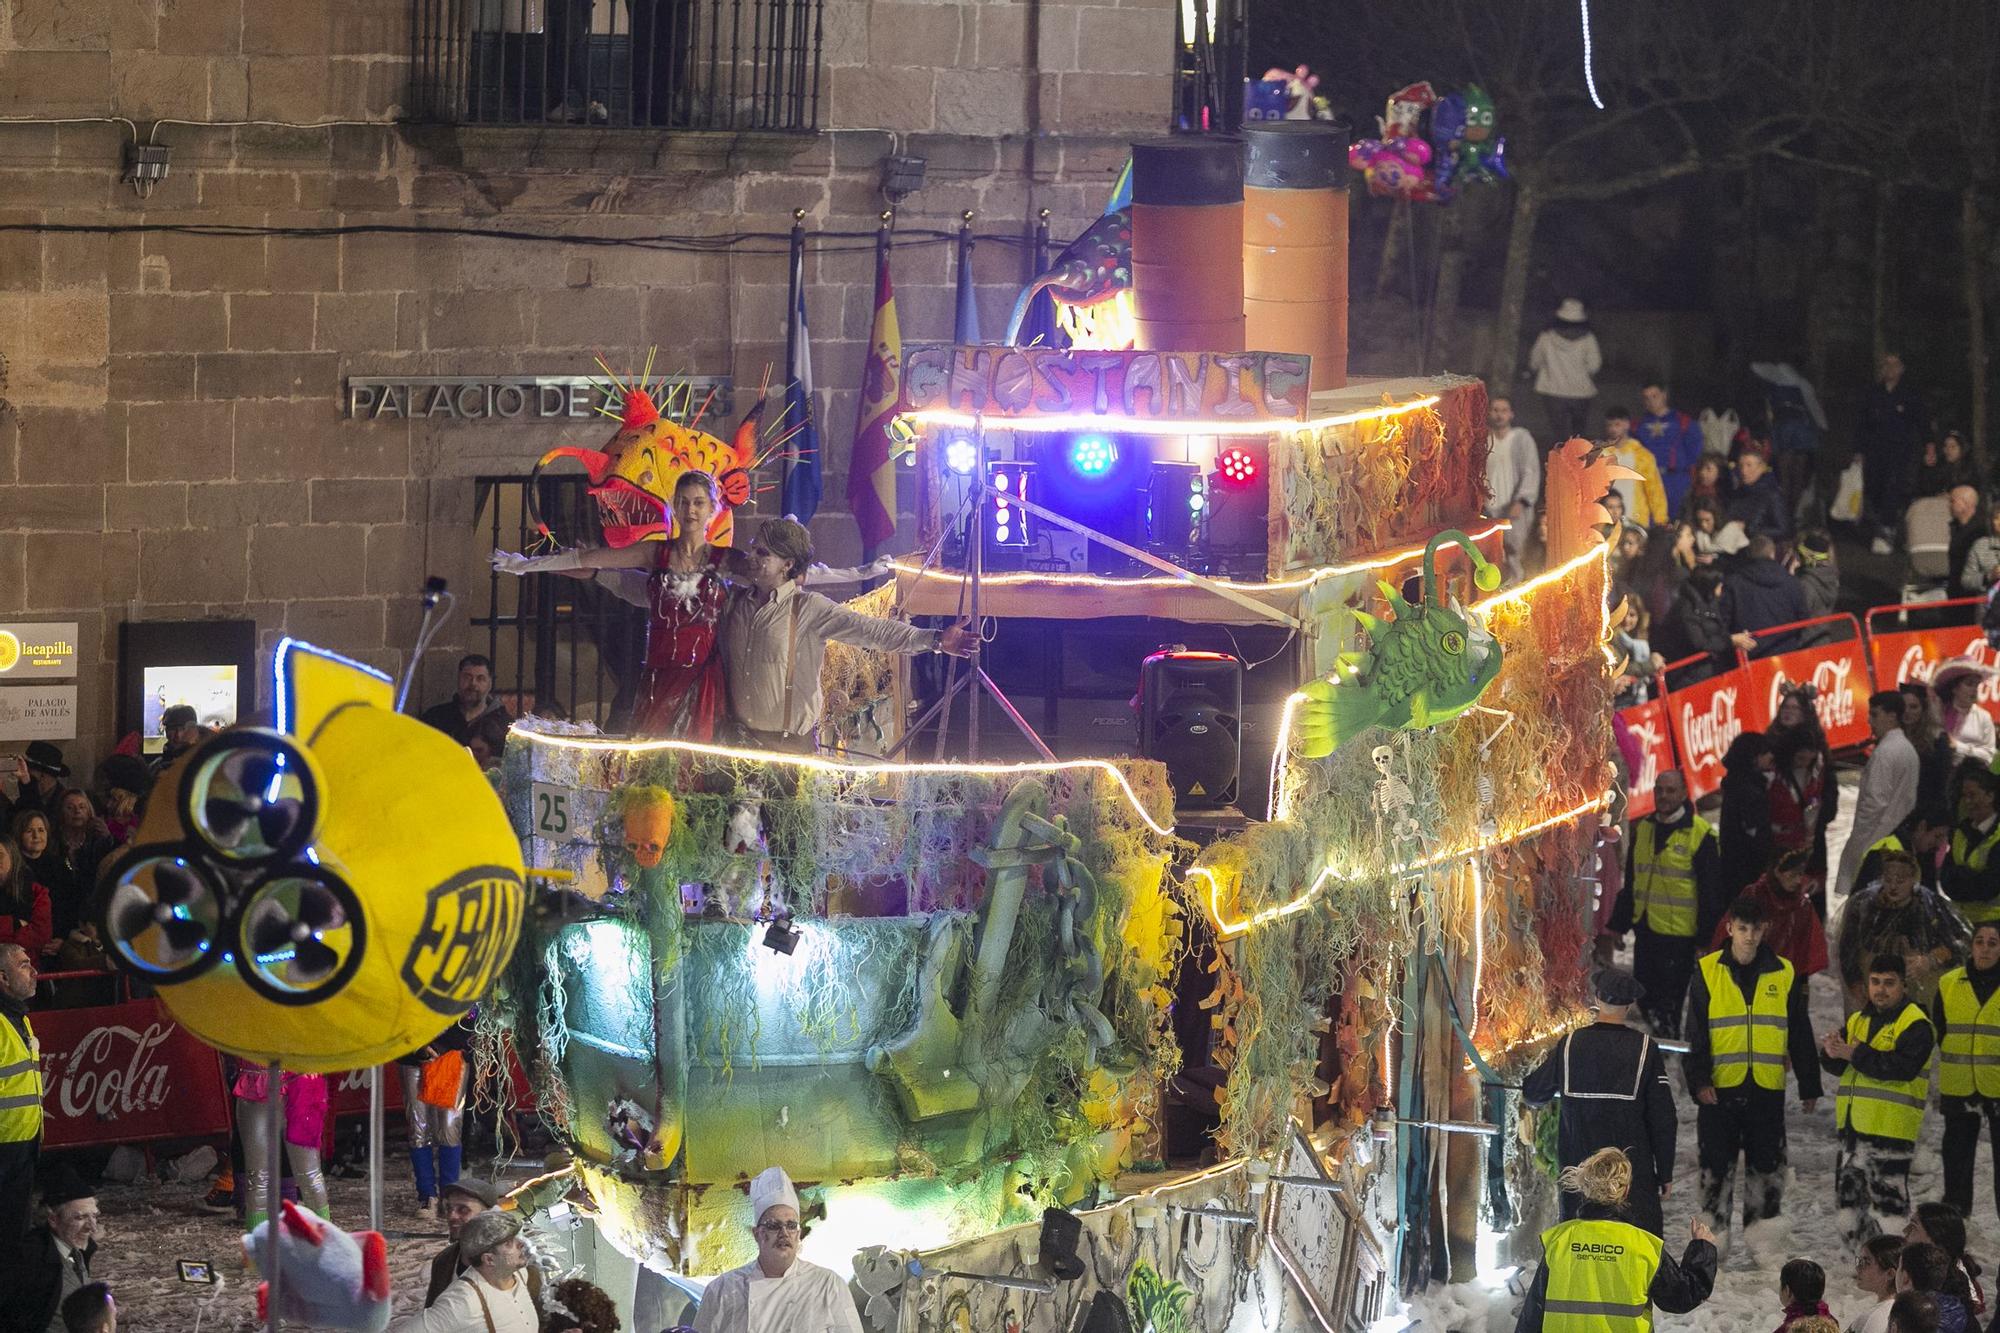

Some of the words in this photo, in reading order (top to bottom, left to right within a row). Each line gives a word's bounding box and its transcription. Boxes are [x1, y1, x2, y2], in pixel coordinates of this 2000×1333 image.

[906, 348, 1303, 417] GHOSTANIC
[351, 386, 526, 418] PALACIO
[540, 384, 590, 417] DE
[601, 385, 732, 418] AILES
[22, 641, 73, 658] lacapilla
[28, 698, 67, 707] PALACIO
[24, 709, 37, 717] DE
[539, 792, 567, 833] 25
[1571, 1242, 1624, 1255] SABICO
[1577, 1254, 1617, 1262] servicios
